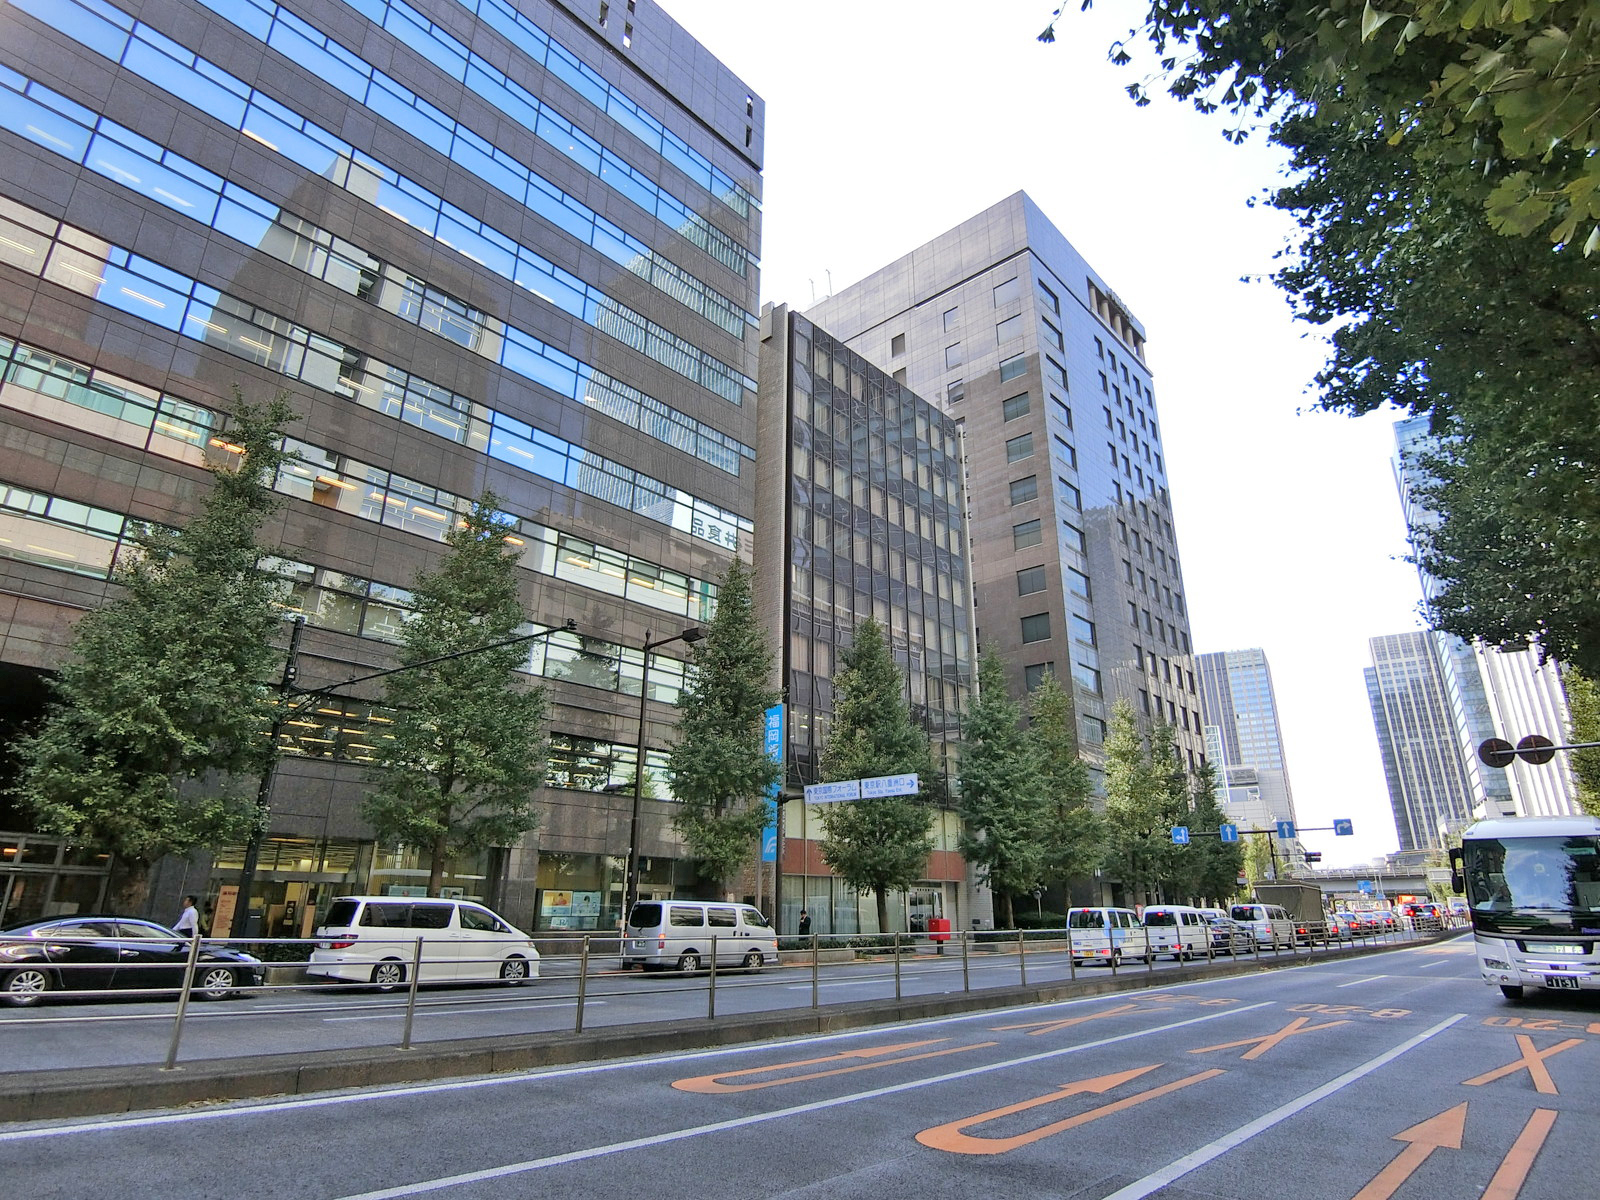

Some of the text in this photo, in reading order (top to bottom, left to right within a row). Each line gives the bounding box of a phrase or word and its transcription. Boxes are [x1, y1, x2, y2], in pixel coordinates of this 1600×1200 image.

[813, 783, 857, 795] 東京国際フォーラム
[1286, 1003, 1412, 1019] 8-20
